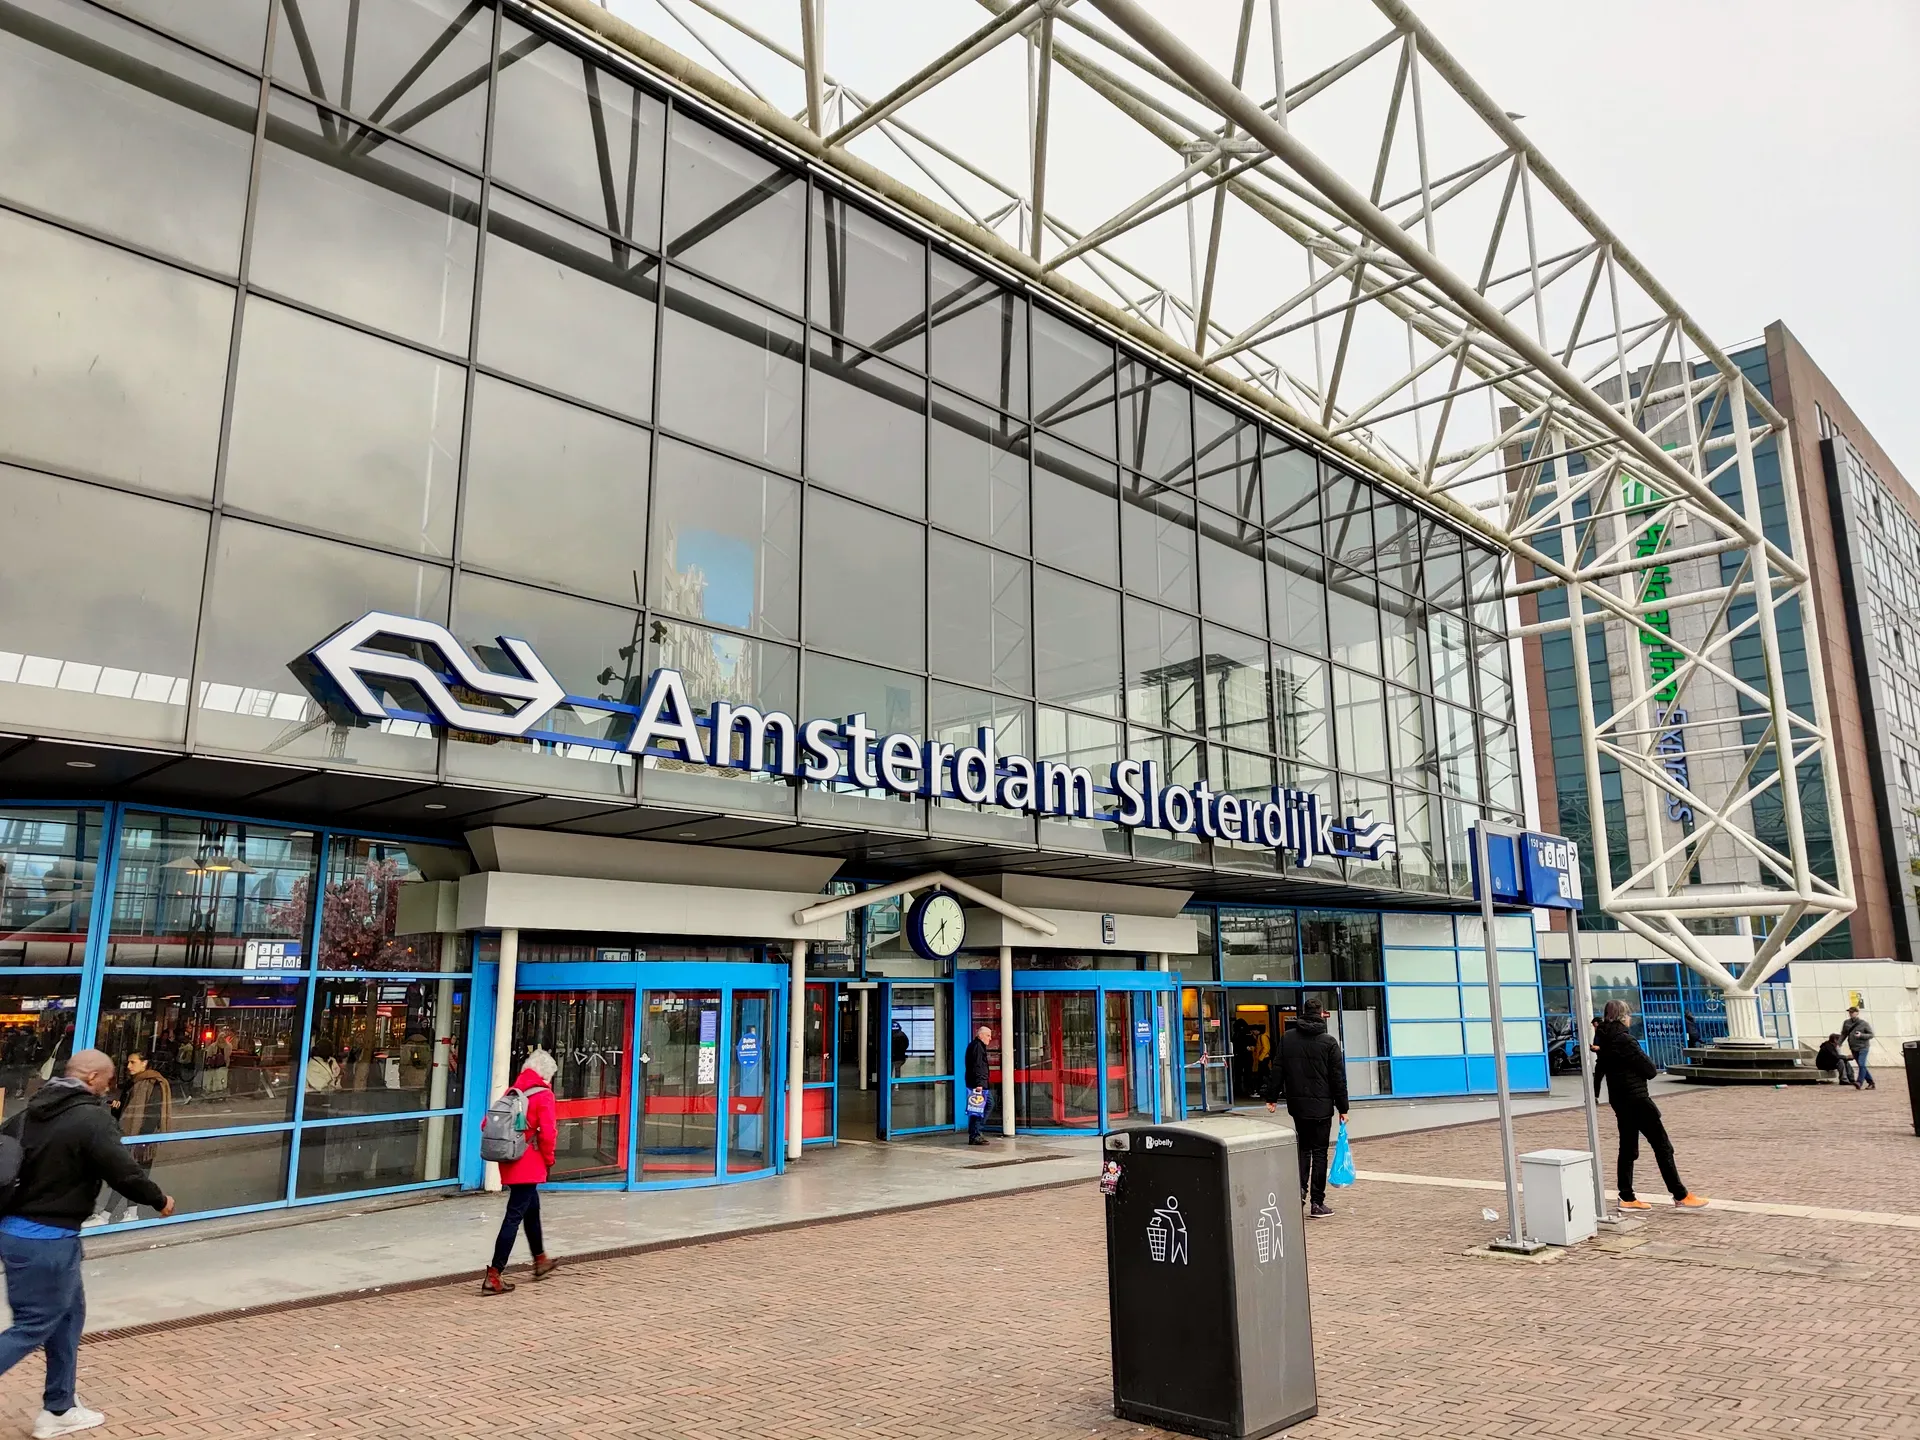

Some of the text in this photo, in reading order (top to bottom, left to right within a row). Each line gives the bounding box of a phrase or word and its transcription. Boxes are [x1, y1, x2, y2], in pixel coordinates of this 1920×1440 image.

[1649, 651, 1685, 701] Inn
[627, 667, 1337, 868] Amsterdam Sloterdijk
[1547, 851, 1565, 867] 9 10
[285, 959, 294, 967] M
[1145, 1135, 1174, 1150] Bigbelly
